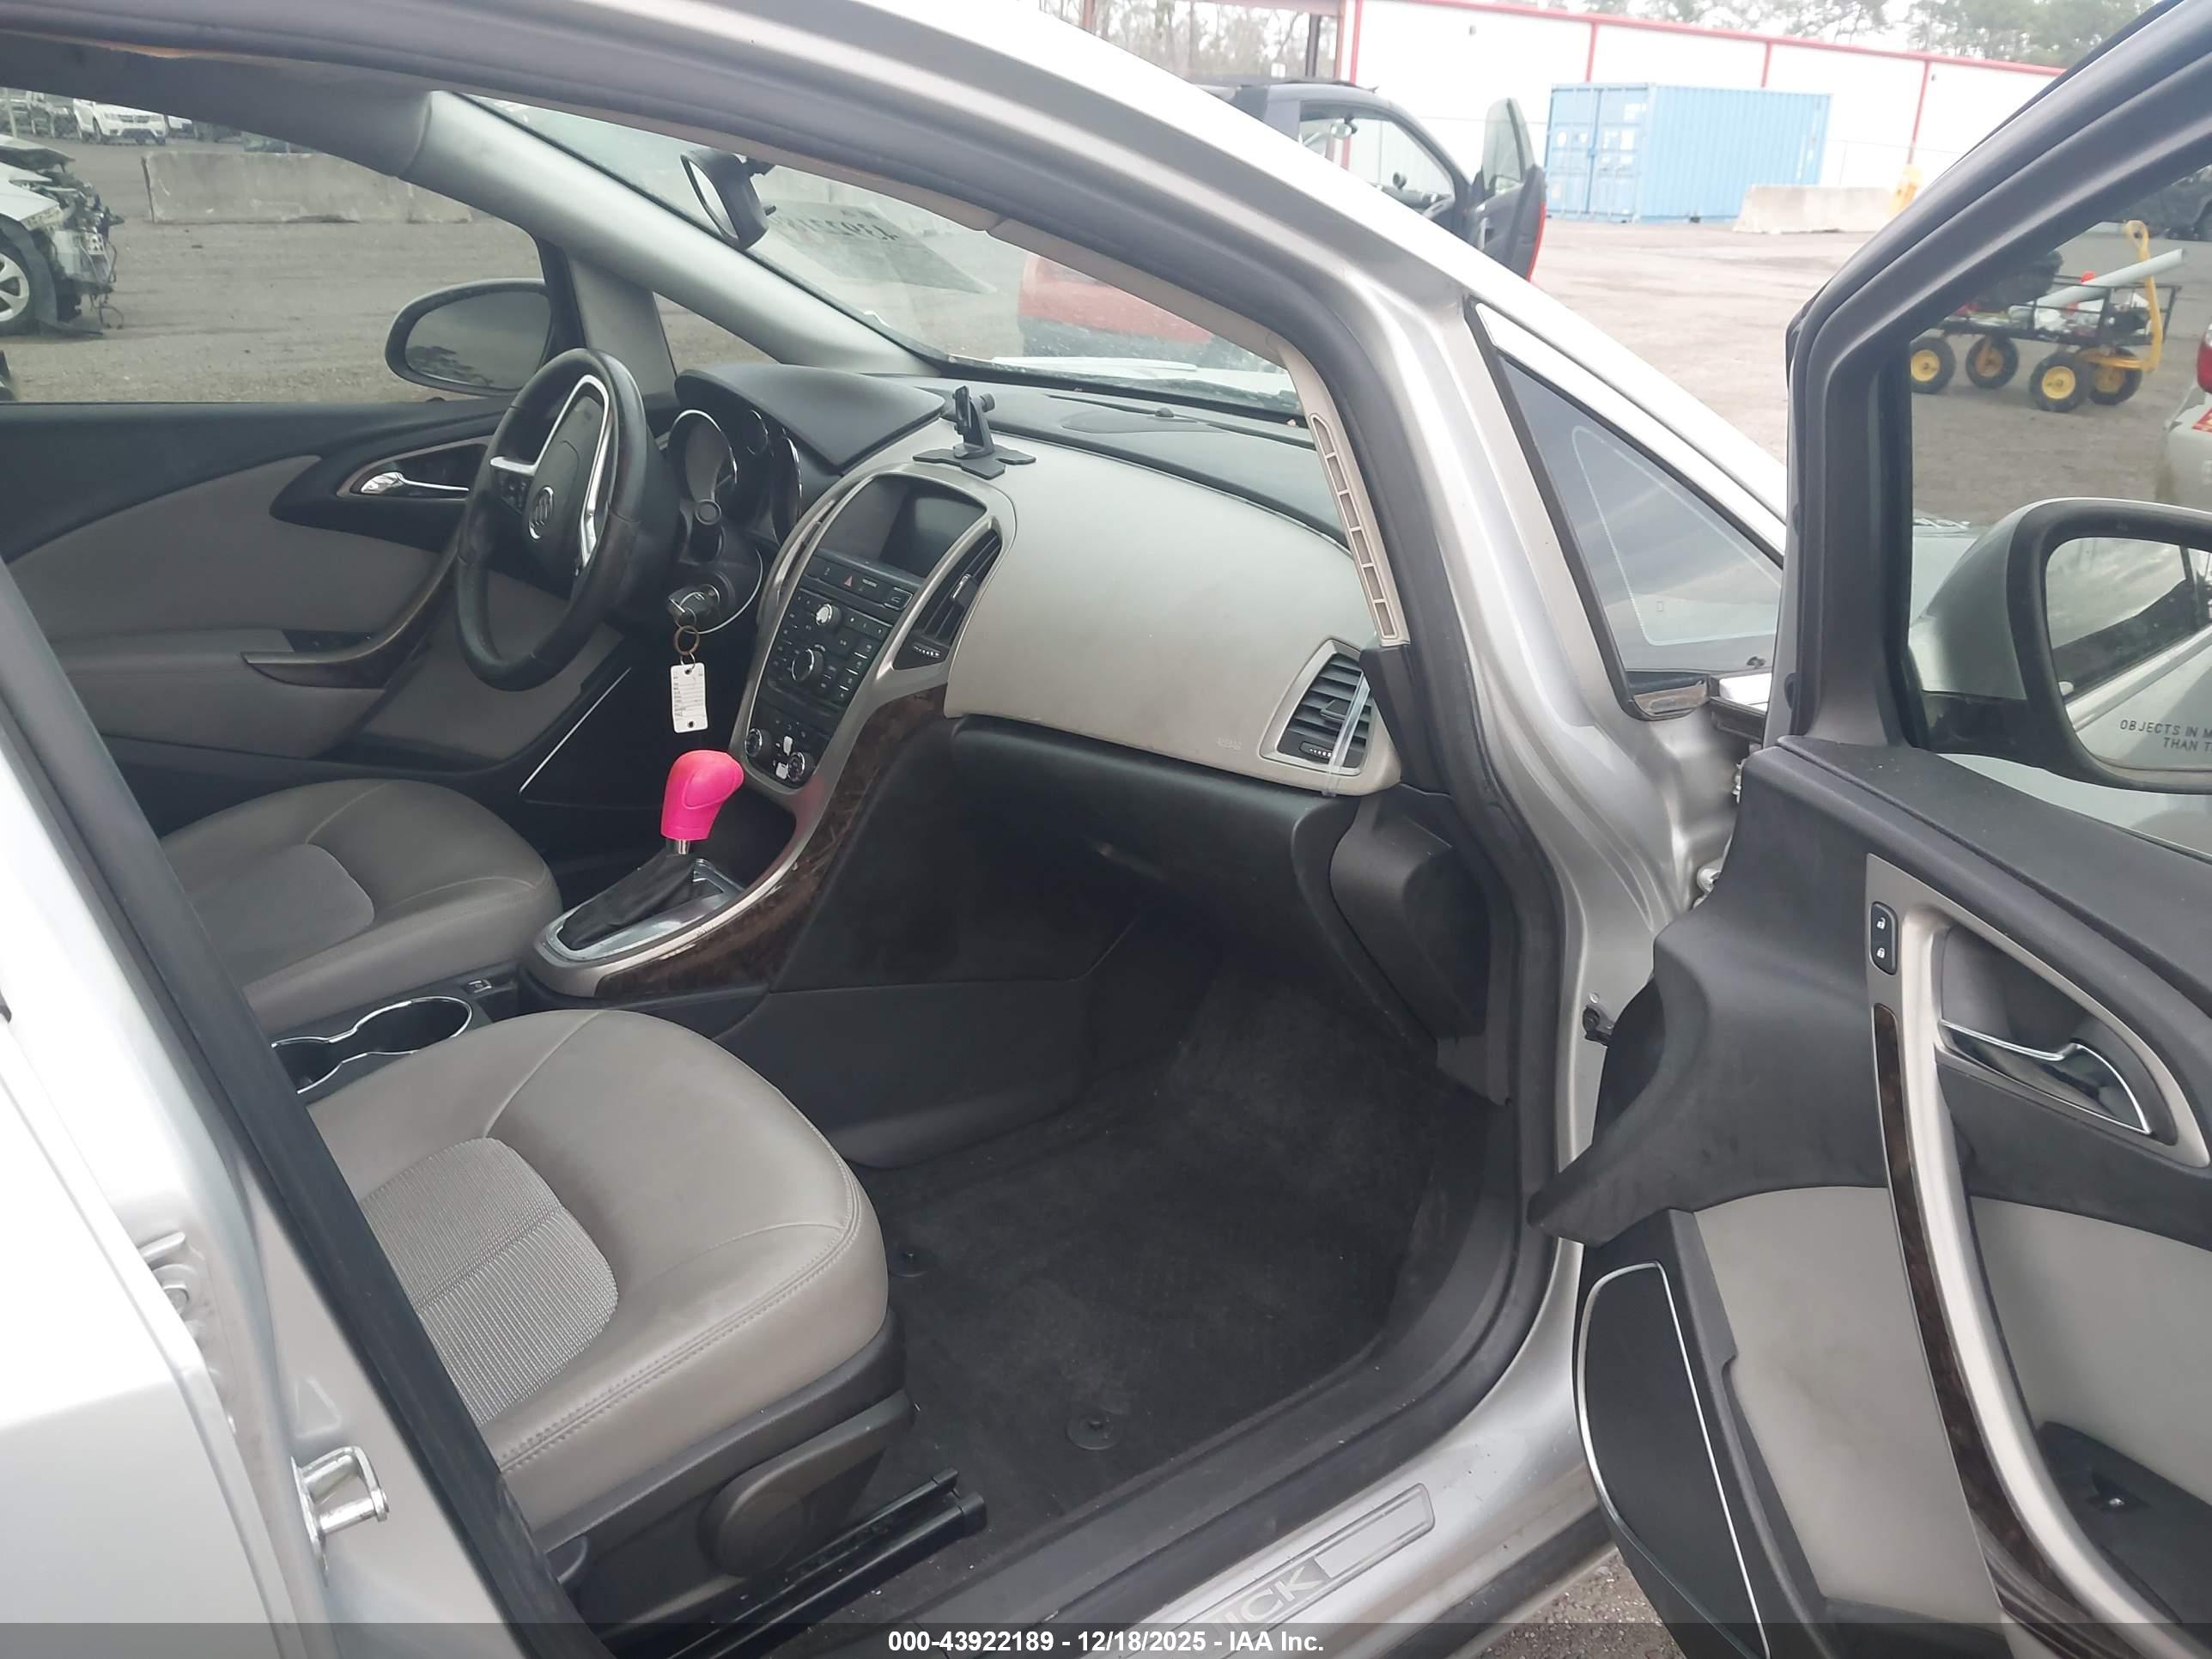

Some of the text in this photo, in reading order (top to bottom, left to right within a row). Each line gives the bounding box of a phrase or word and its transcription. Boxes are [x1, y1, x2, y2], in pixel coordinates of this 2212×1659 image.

[2120, 720, 2181, 735] OBJECTS
[2185, 726, 2198, 738] IN
[2164, 737, 2198, 751] THAN
